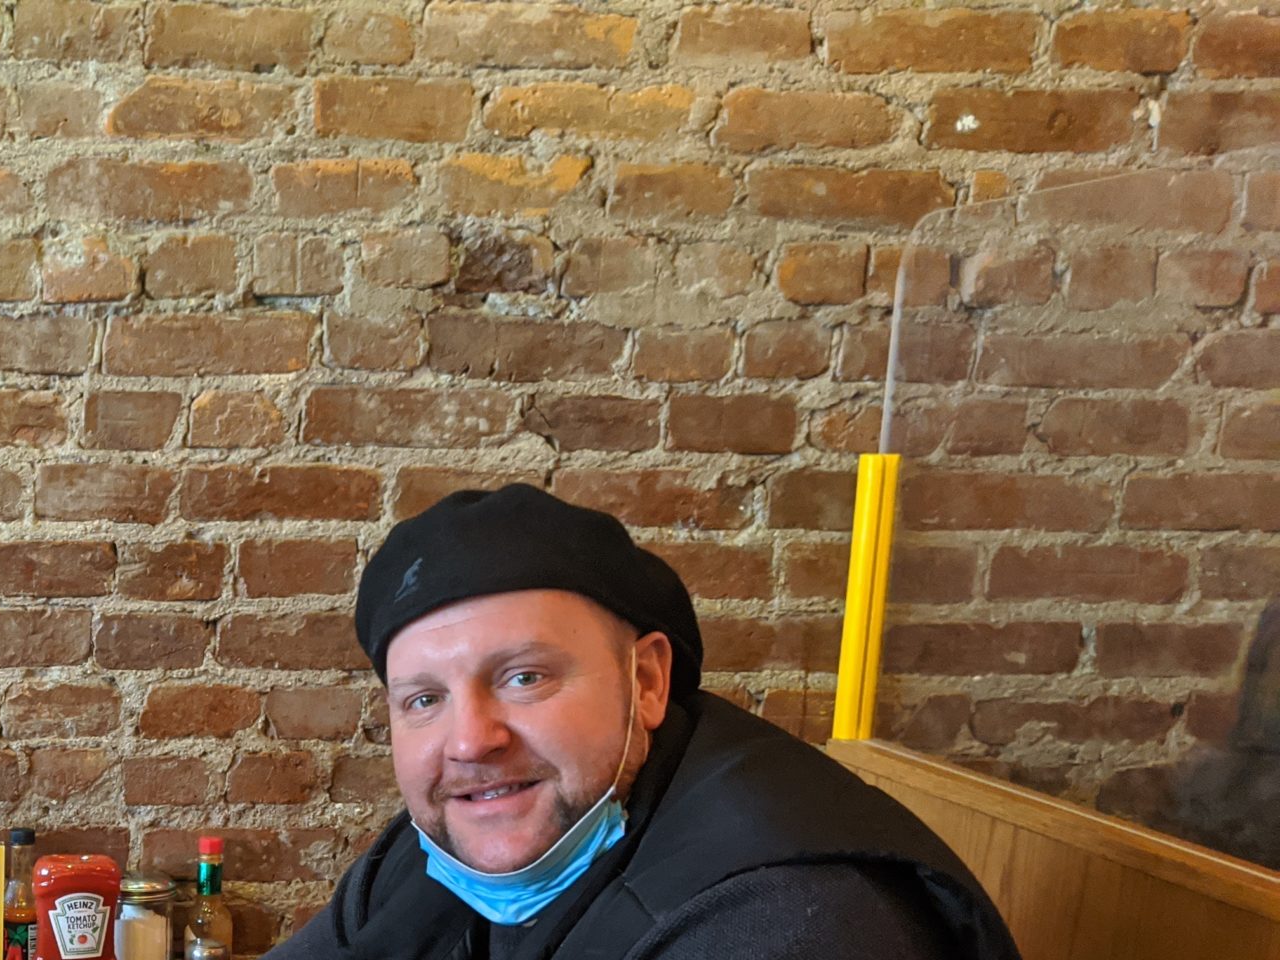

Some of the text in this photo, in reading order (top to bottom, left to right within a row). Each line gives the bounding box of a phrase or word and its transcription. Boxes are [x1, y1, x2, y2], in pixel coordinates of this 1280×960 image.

[66, 901, 94, 911] HEINZ
[66, 914, 97, 924] TOMATO
[67, 922, 96, 930] KETCHUP
